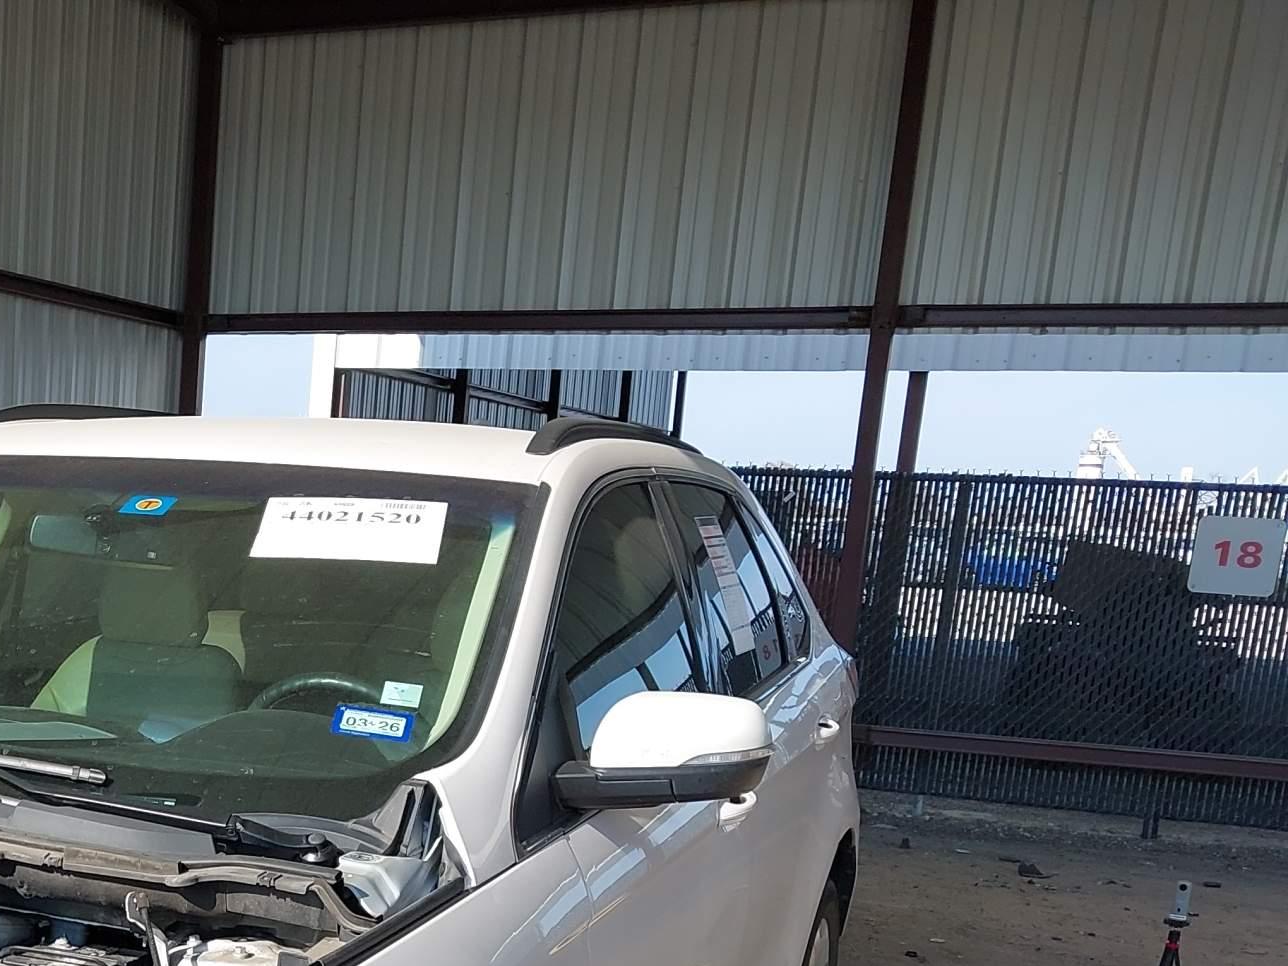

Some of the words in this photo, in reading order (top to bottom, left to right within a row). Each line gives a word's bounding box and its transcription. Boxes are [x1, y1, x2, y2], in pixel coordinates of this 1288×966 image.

[281, 510, 421, 524] 44021520
[1214, 540, 1263, 569] 18
[345, 716, 368, 727] 03
[378, 721, 400, 733] 26
